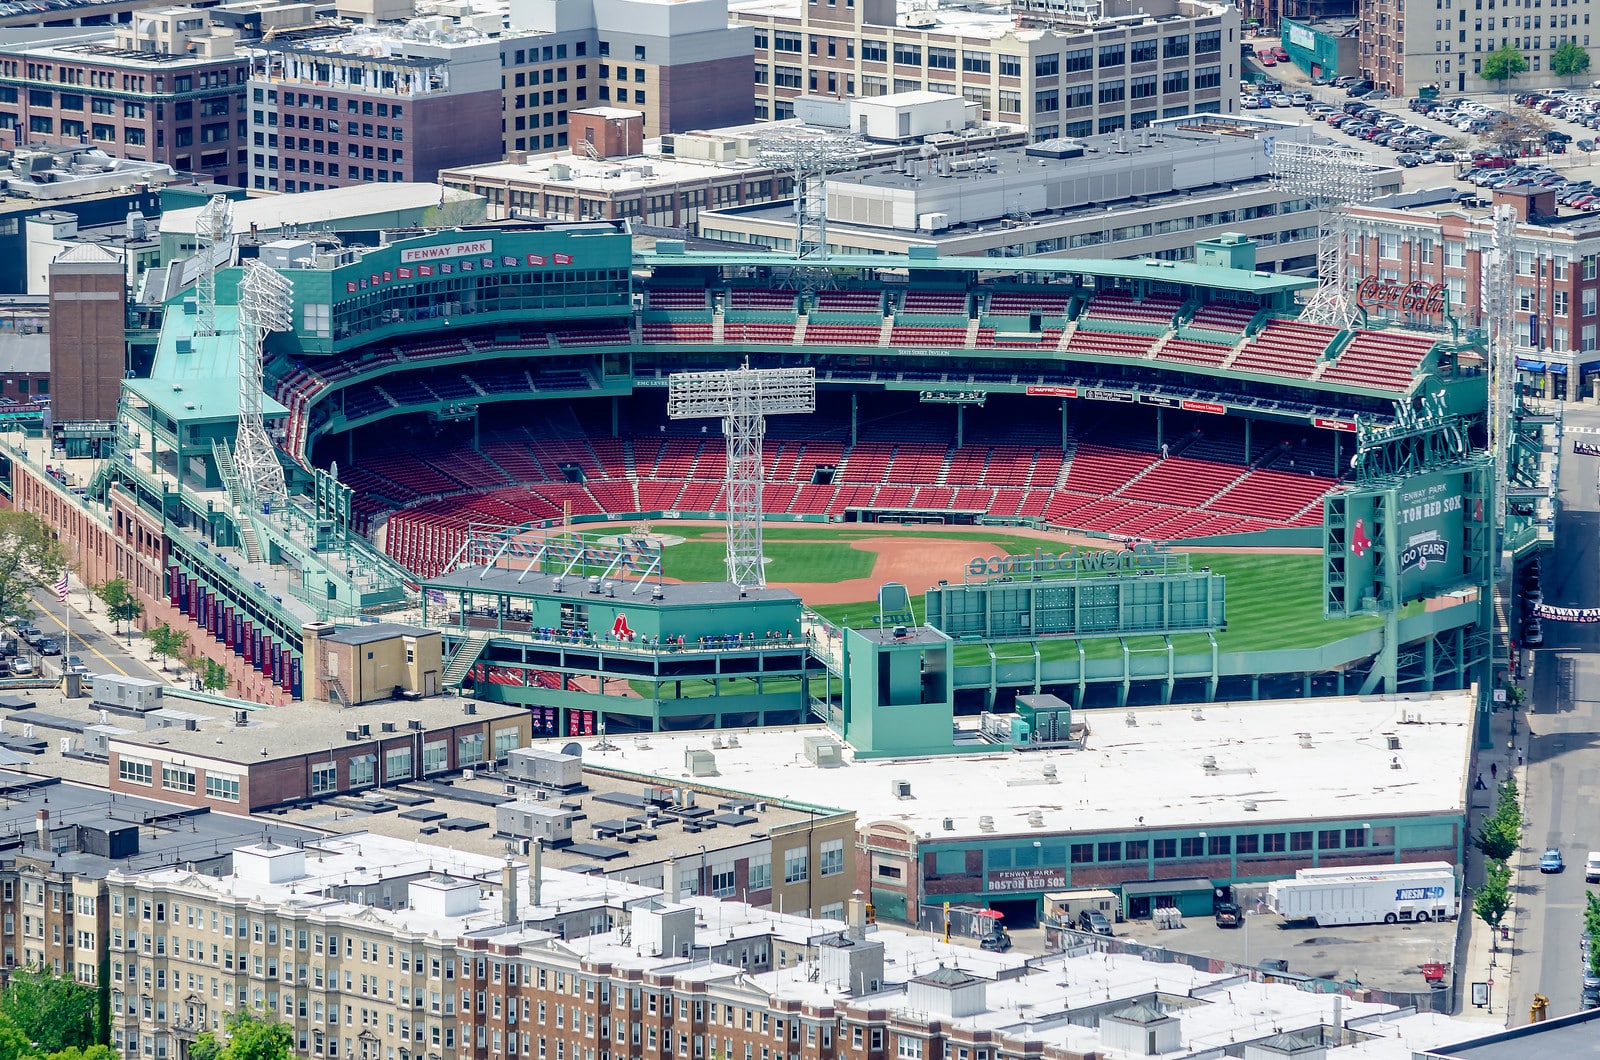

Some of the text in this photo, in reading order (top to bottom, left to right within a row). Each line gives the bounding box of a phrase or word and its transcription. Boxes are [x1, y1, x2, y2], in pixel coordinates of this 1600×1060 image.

[407, 243, 486, 260] FENWAY PARK
[1429, 484, 1447, 494] PARK
[1424, 501, 1441, 518] RED
[1444, 495, 1461, 512] SOX
[1417, 544, 1444, 557] YEARS
[1534, 603, 1579, 616] FENWAY
[989, 877, 1066, 890] BOSTON RED SOX
[1401, 889, 1425, 899] NESN
